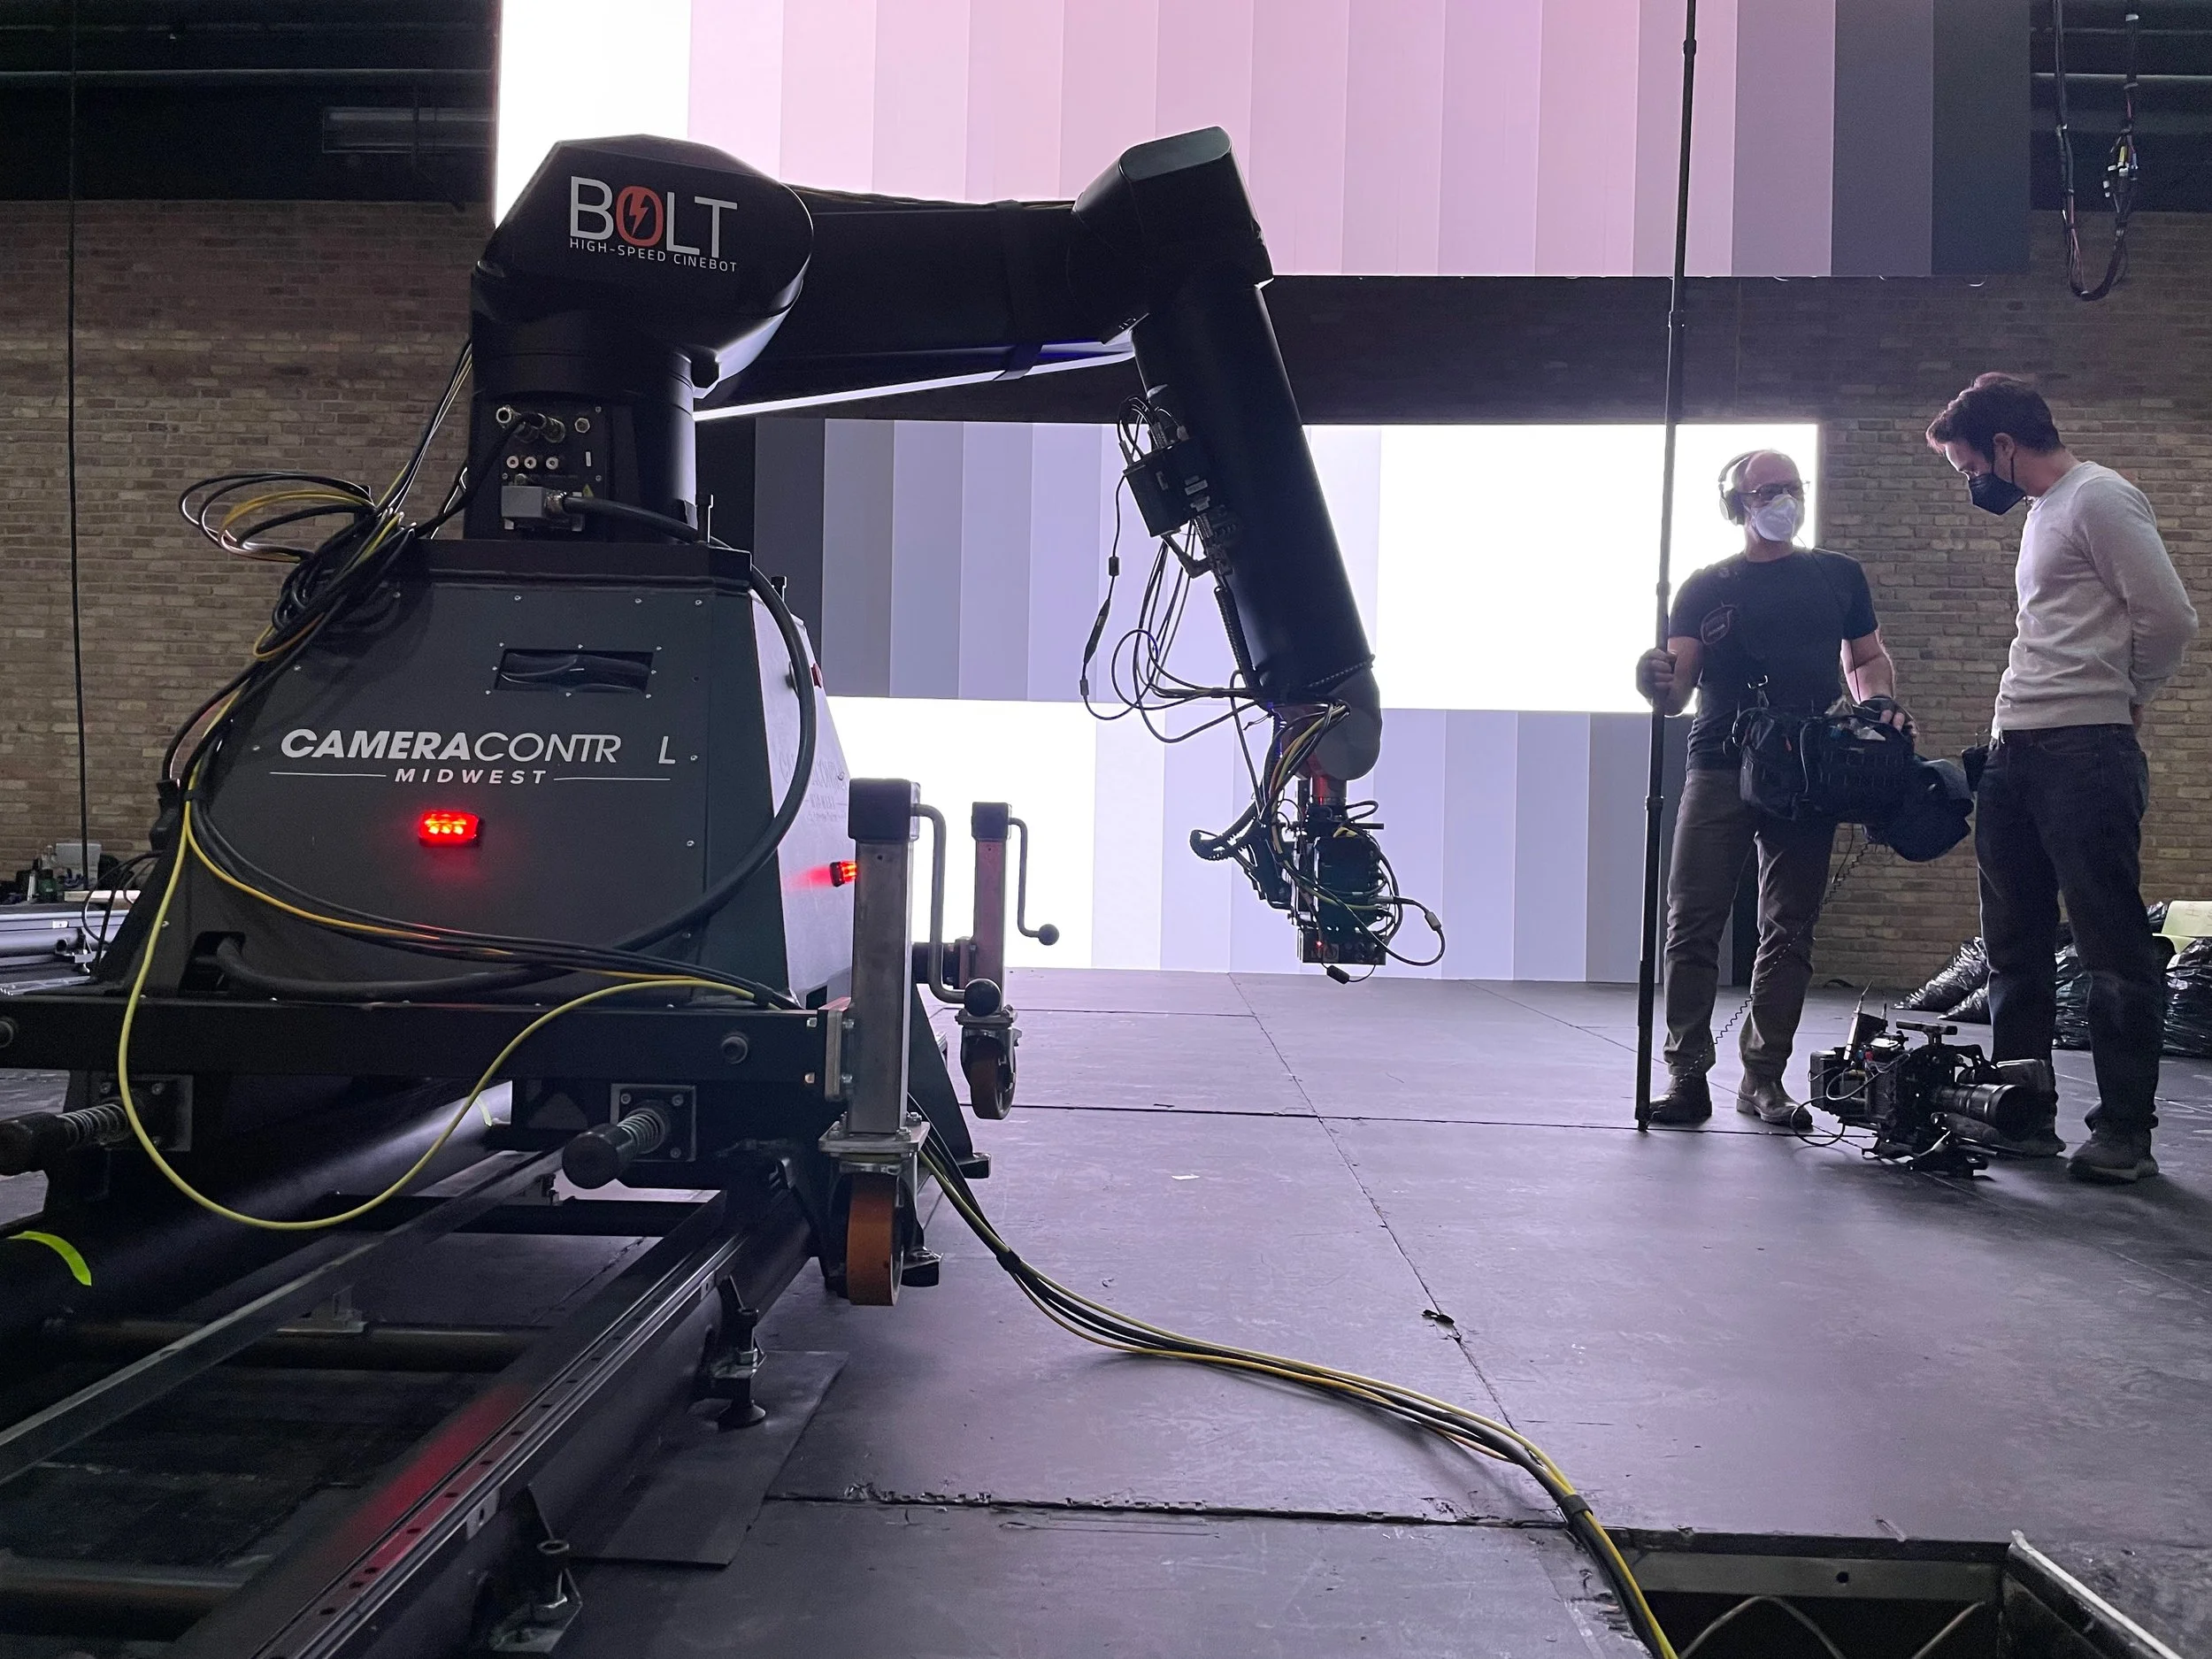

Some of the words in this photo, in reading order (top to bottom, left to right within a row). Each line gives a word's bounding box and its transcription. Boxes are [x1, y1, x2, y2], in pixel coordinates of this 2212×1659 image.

[570, 176, 738, 259] BOLT
[569, 237, 666, 262] HIGH-SPEED
[673, 253, 737, 273] CINEBOT
[395, 768, 547, 785] MIDWEST
